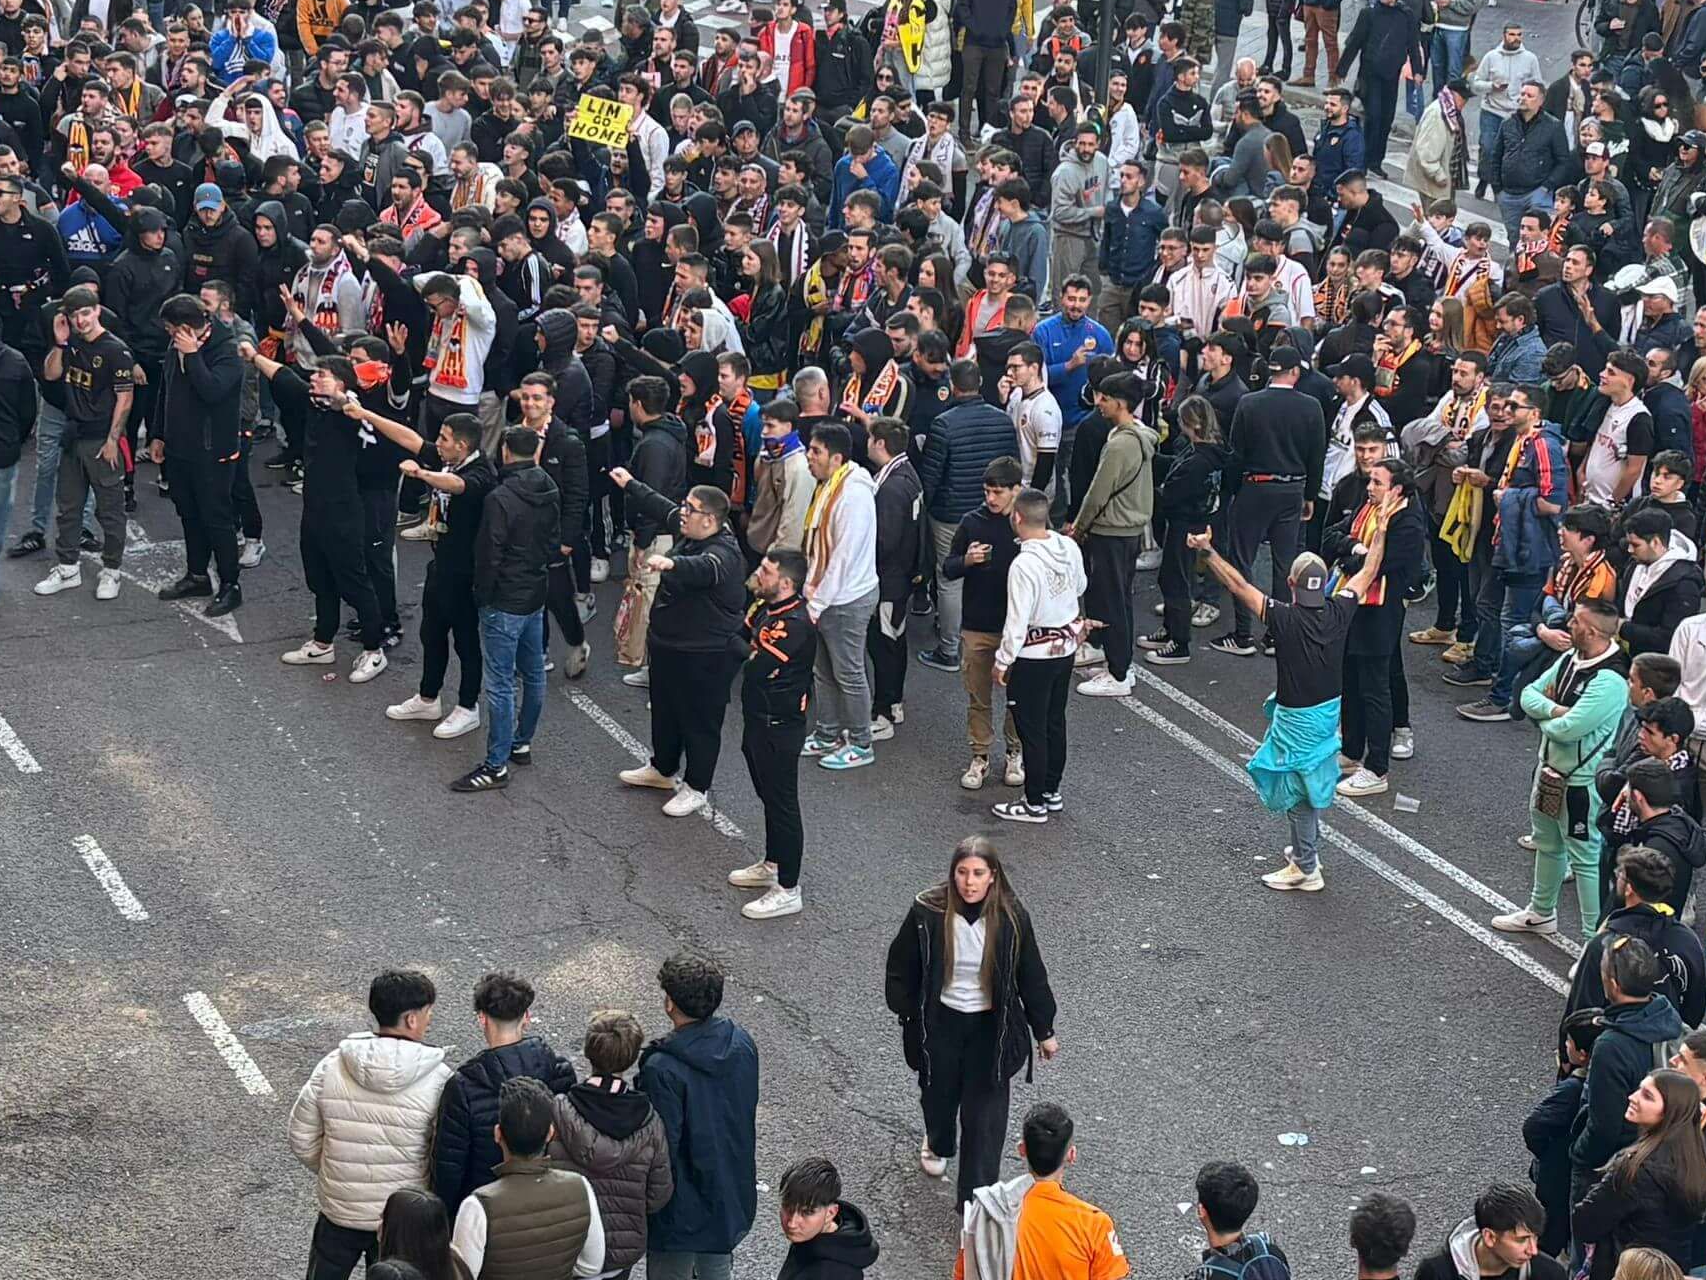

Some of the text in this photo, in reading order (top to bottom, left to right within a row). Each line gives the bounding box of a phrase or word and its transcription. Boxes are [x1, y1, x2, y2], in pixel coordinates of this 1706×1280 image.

[586, 98, 622, 119] LIM
[593, 115, 612, 127] GO
[572, 121, 626, 145] HOME
[68, 240, 107, 253] adidas
